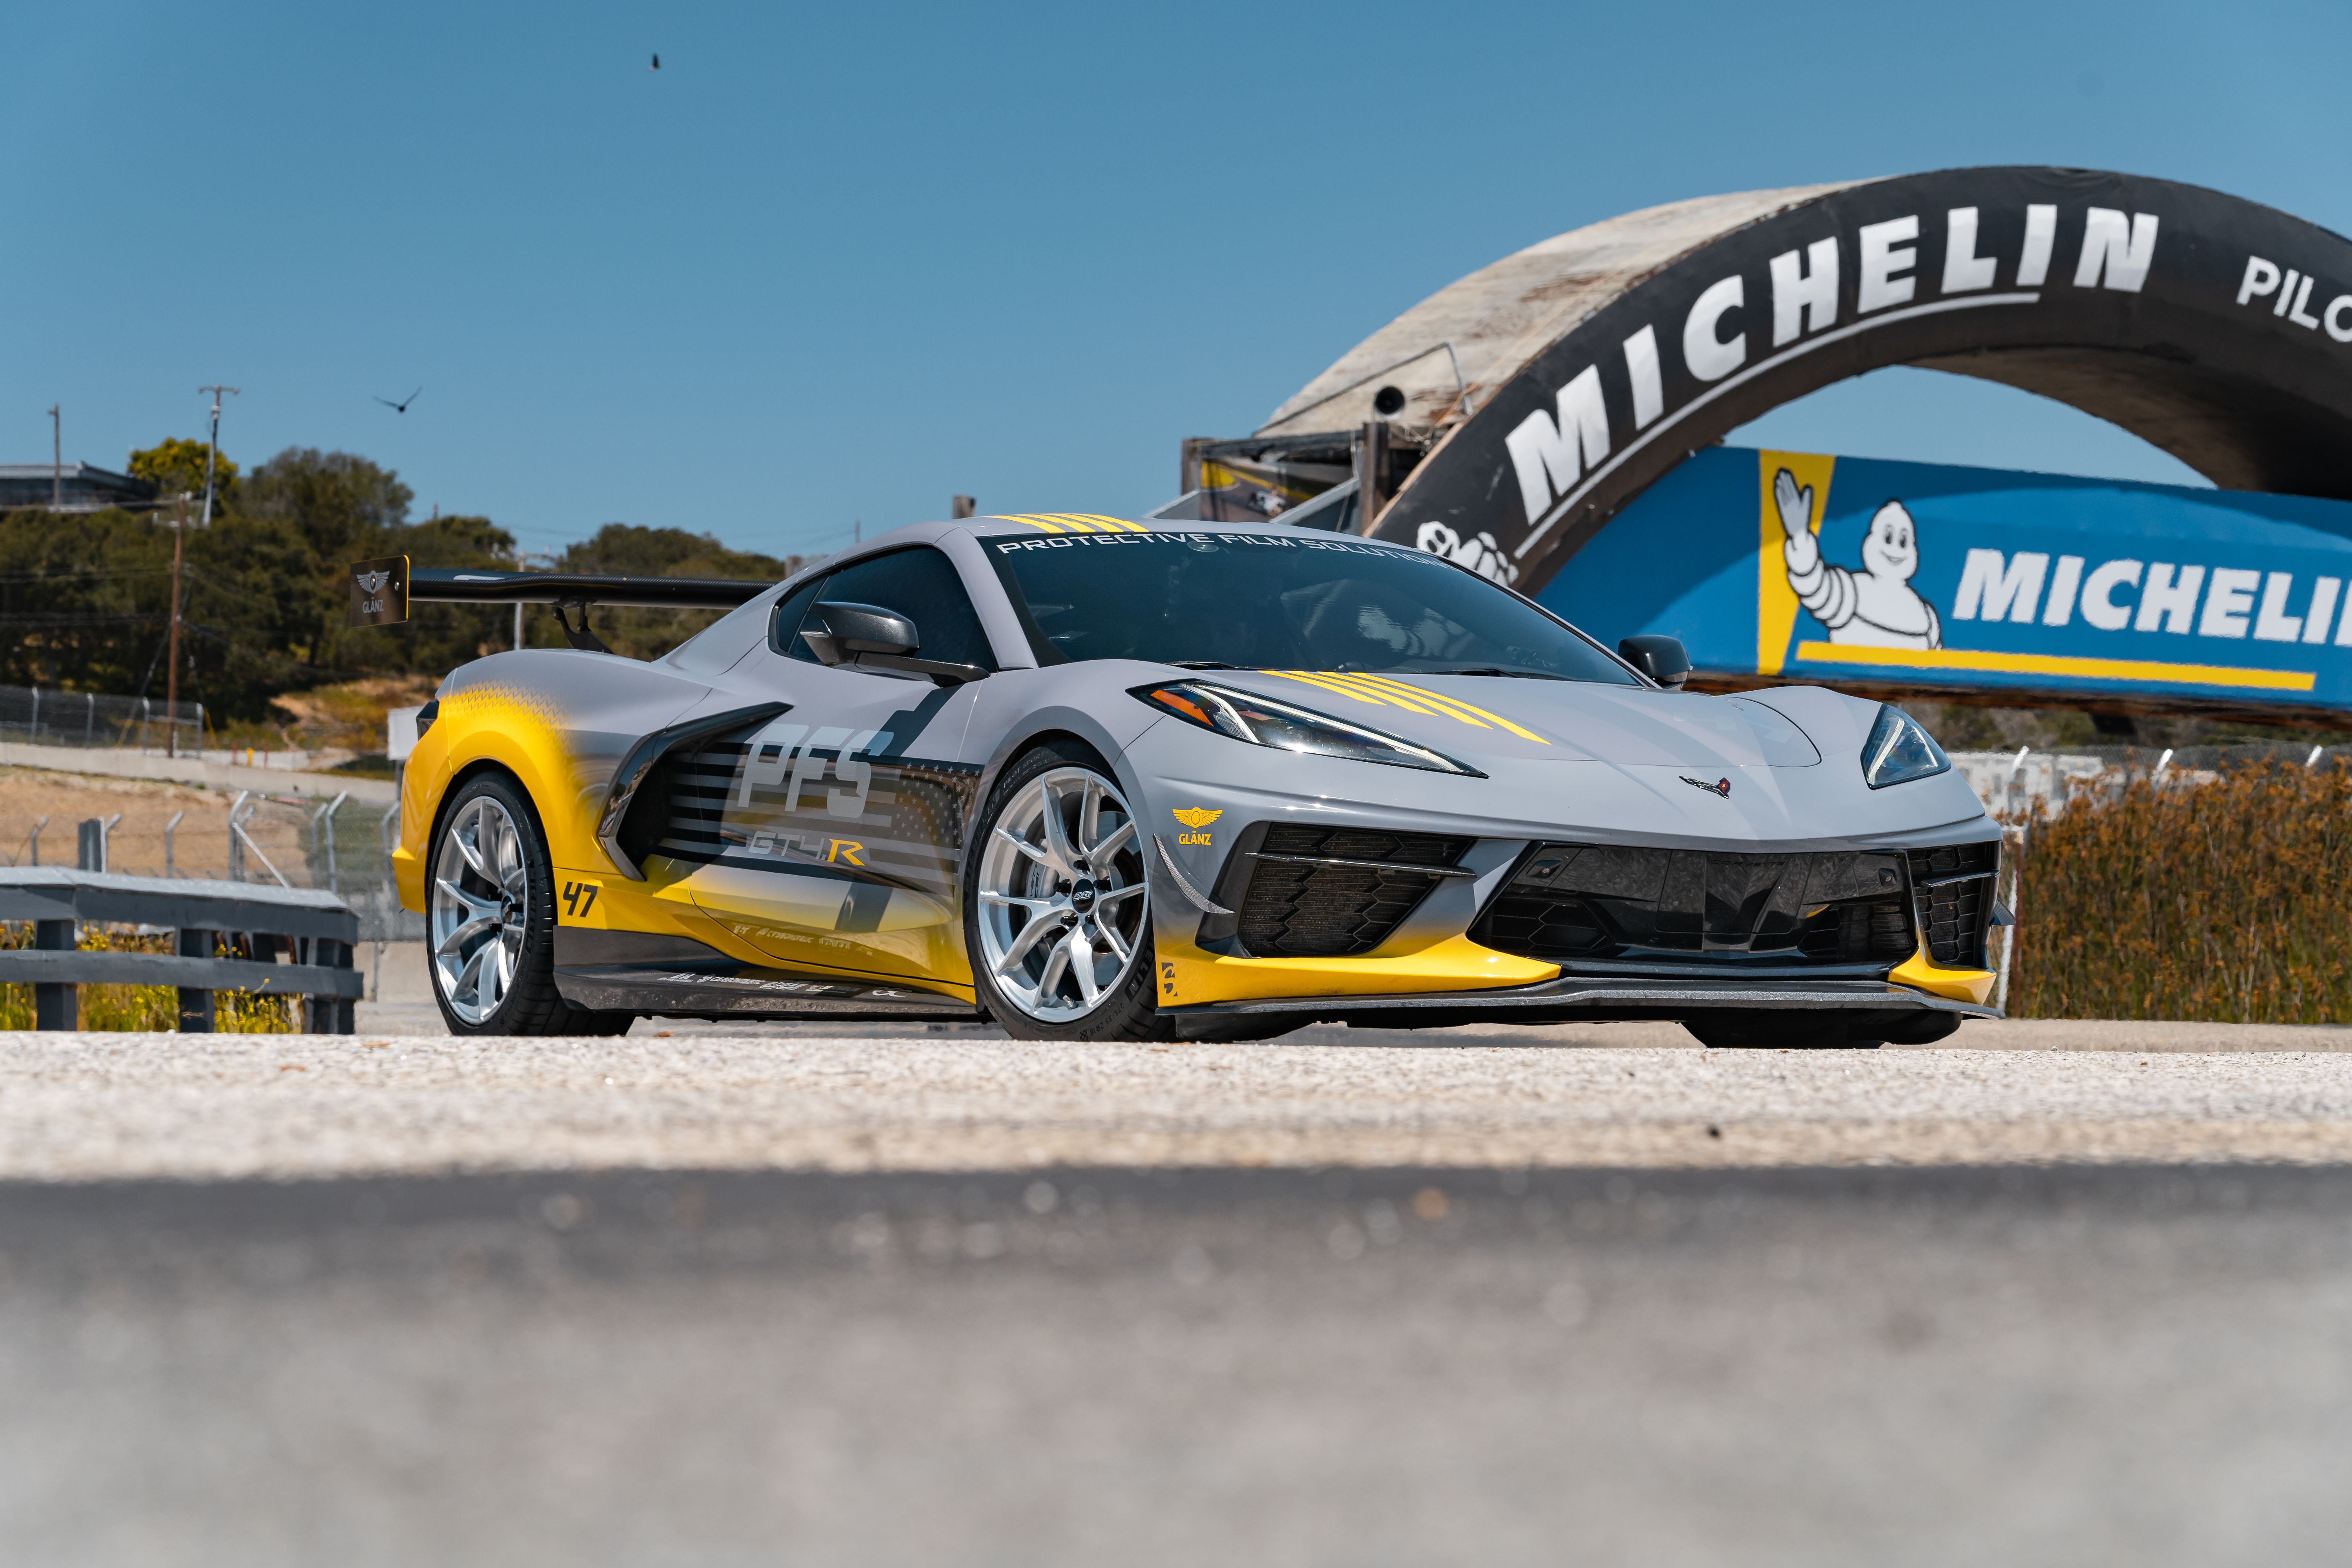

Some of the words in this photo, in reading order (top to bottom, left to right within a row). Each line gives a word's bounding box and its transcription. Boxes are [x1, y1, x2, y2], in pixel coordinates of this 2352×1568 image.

[1505, 204, 2159, 525] MICHELIN
[996, 533, 1215, 554] PROTECTIVE
[1217, 534, 1297, 548] FILM
[363, 596, 384, 613] GLÄNZ
[1951, 548, 2352, 647] MICHELI
[737, 723, 894, 818] PFS
[1179, 830, 1212, 845] GLÄNZ
[563, 881, 598, 918] 47
